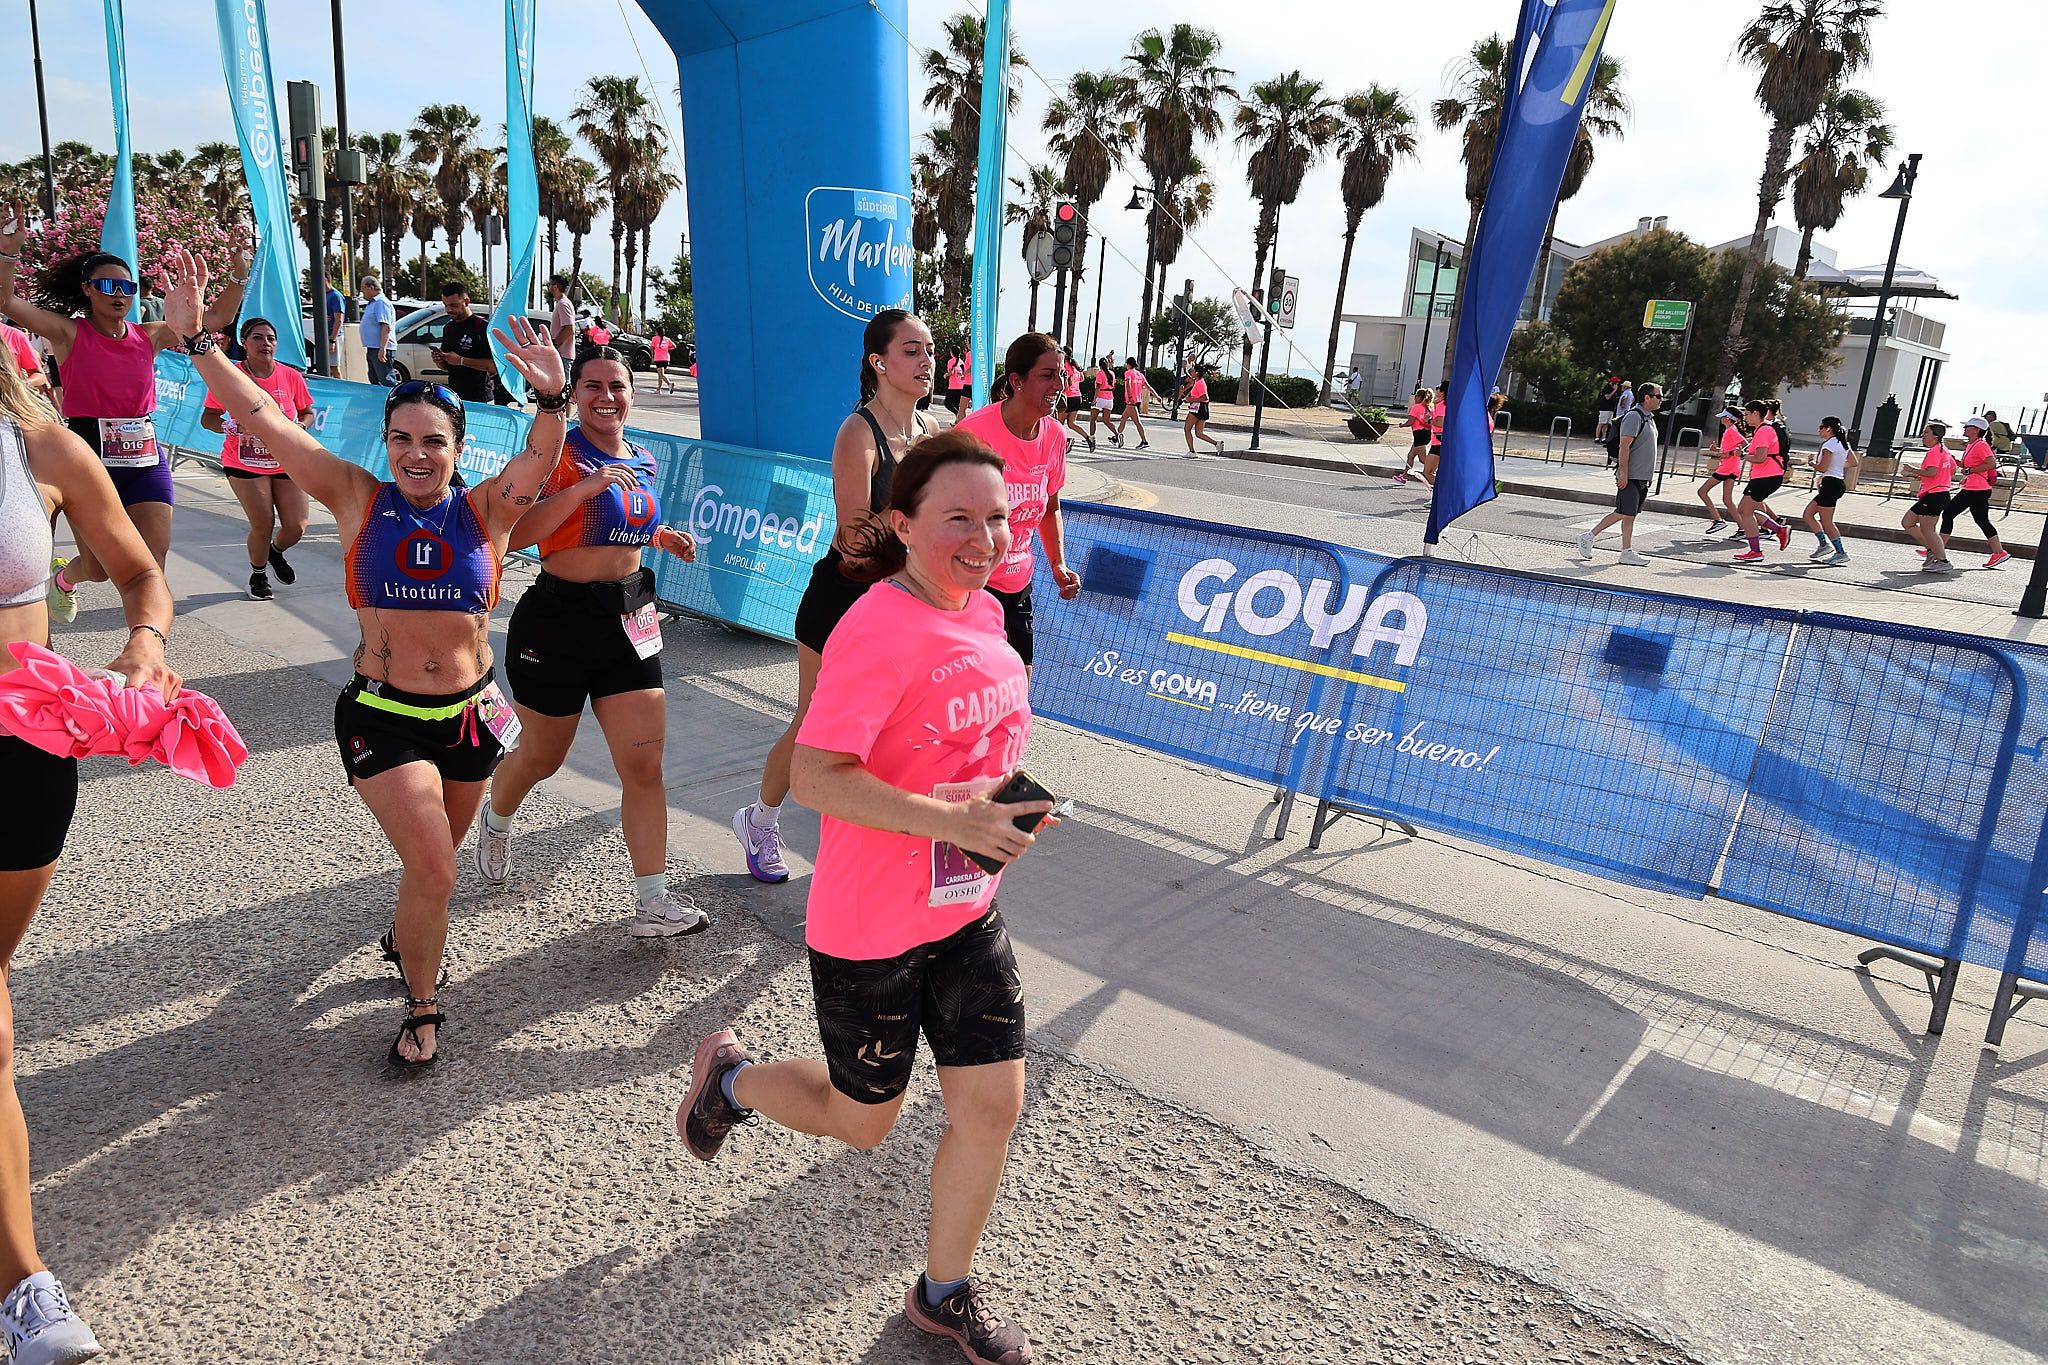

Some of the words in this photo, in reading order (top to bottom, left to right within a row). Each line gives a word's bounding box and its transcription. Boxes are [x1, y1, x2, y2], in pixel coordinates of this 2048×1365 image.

[828, 283, 853, 307] HIJA
[857, 300, 872, 313] DE
[978, 351, 985, 361] de
[122, 440, 144, 450] 016
[688, 485, 823, 554] Compeed
[723, 553, 766, 573] AMPOLLAS
[384, 582, 461, 600] Litotúria
[637, 613, 654, 629] 016
[1178, 558, 1428, 667] GOYA
[932, 651, 984, 683] OYSHO
[945, 675, 1026, 733] CARRE
[1082, 650, 1122, 678] ¡Si
[1121, 668, 1148, 686] es
[1150, 670, 1218, 704] GOYA
[1291, 711, 1344, 745] que
[1345, 722, 1393, 746] ser
[1396, 721, 1500, 771] bueno!
[945, 793, 971, 802] SUMA
[945, 874, 973, 884] CARRERA
[974, 872, 981, 881] DE
[944, 885, 981, 899] OYSHO
[982, 1014, 1008, 1023] NEBBIA
